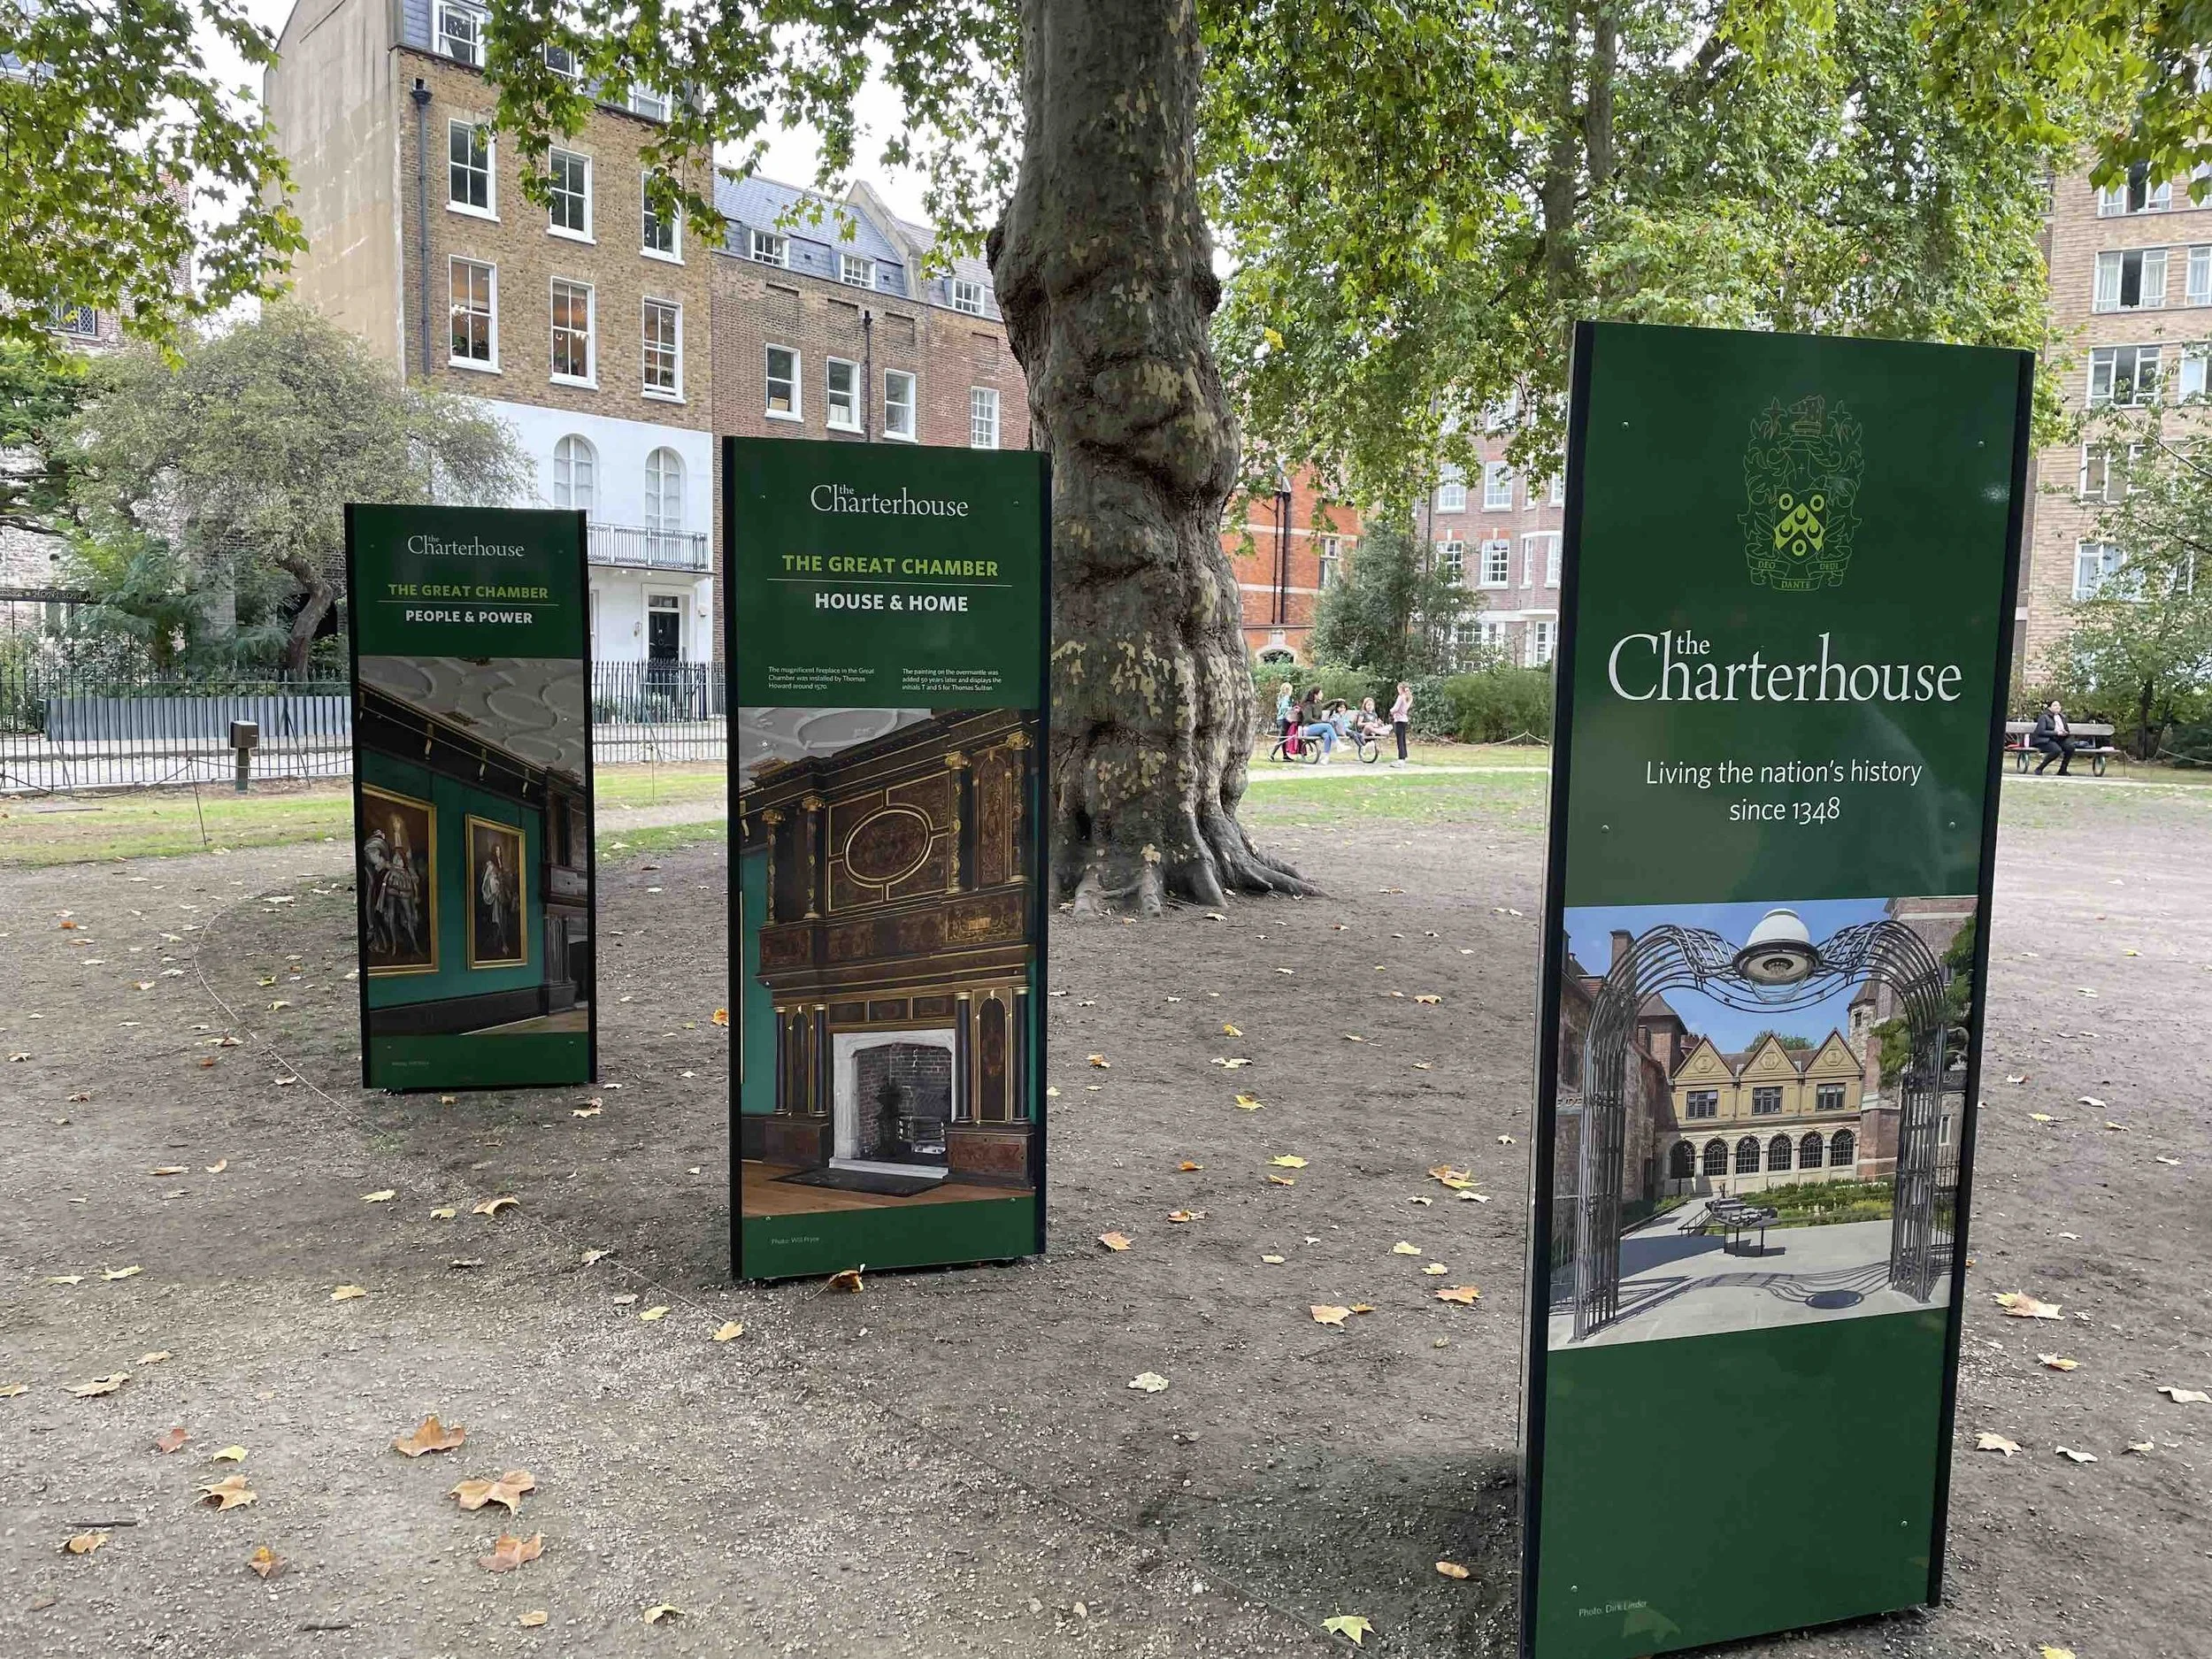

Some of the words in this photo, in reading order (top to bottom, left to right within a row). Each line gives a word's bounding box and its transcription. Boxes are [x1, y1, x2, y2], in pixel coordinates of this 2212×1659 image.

[811, 485, 968, 516] Charterhouse
[840, 485, 855, 495] the
[407, 534, 525, 557] Charterhouse
[428, 534, 440, 543] the
[782, 556, 822, 571] THE
[829, 557, 895, 572] GREAT
[902, 559, 997, 576] CHAMBER
[388, 584, 418, 595] THE
[422, 585, 471, 596] GREAT
[476, 587, 548, 598] CHAMBER
[816, 594, 883, 609] HOUSE
[890, 595, 902, 610] &
[910, 595, 967, 611] HOME
[406, 611, 460, 622] PEOPLE
[465, 611, 474, 622] &
[480, 612, 532, 623] POWER
[1677, 631, 1711, 656] the
[1609, 630, 1962, 701] Charterhouse
[1647, 762, 1711, 788] Living
[1718, 760, 1753, 783] the
[1762, 760, 1843, 782] nation's
[1852, 759, 1922, 786] history
[1730, 799, 1785, 820] since
[1793, 797, 1839, 825] 1348
